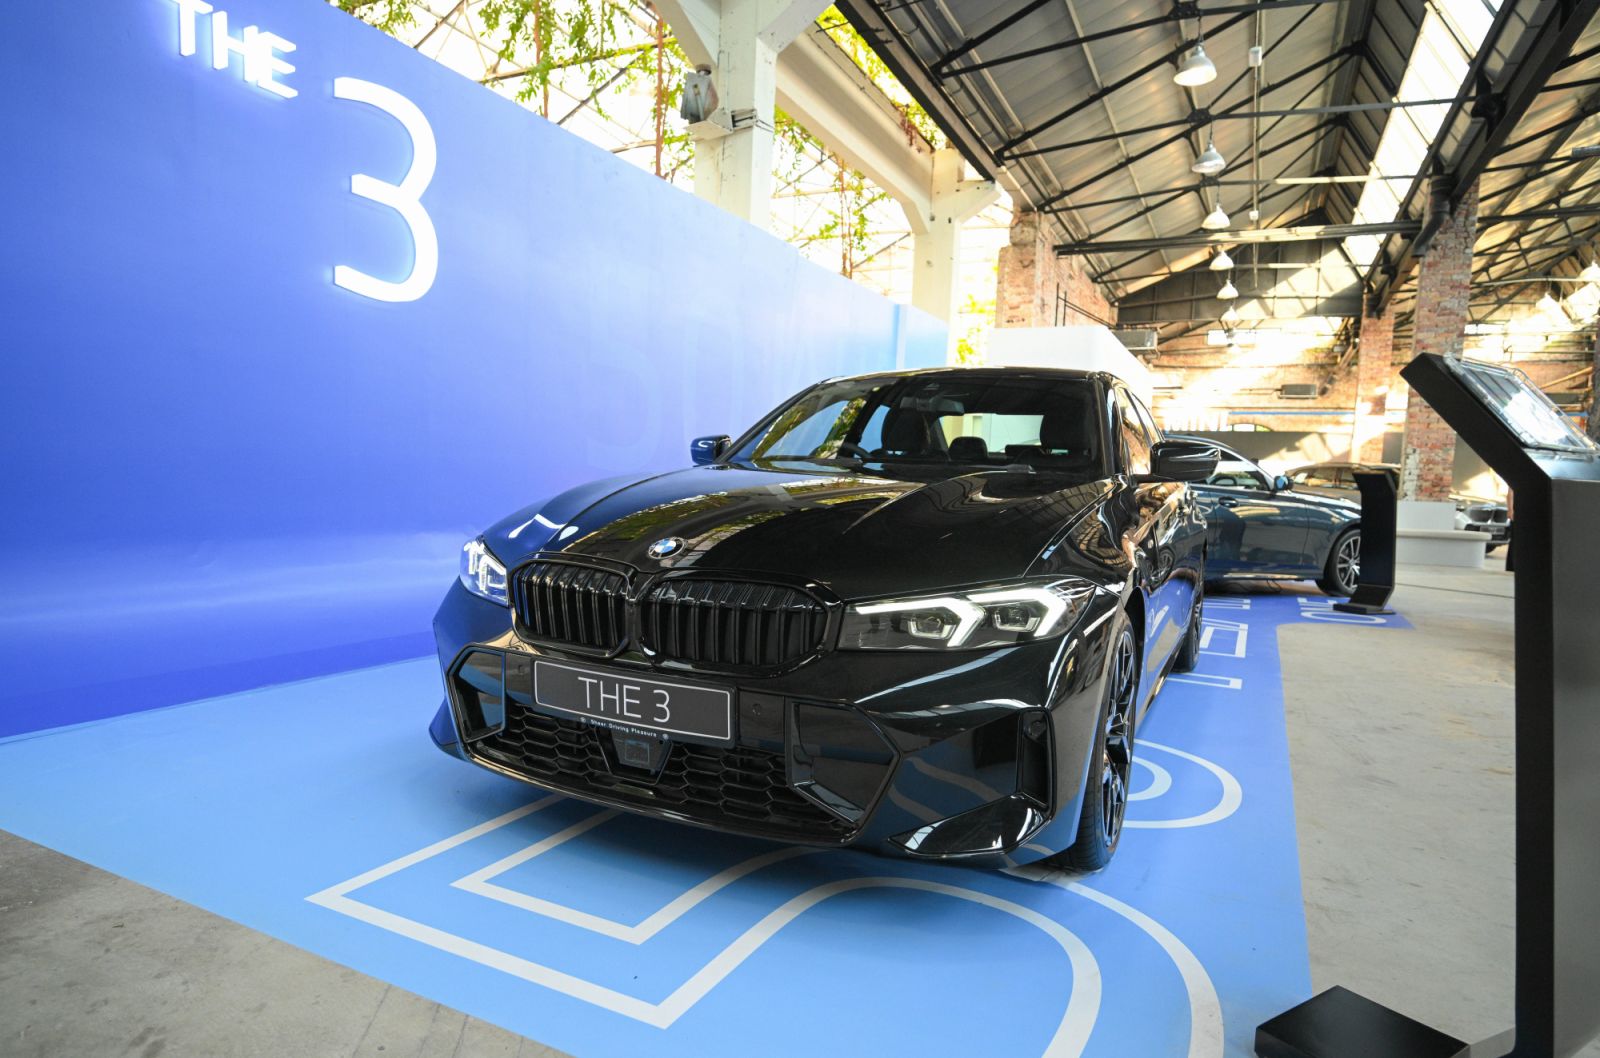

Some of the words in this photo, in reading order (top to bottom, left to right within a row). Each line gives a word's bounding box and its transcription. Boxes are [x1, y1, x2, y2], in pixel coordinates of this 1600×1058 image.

[170, 0, 299, 99] THE
[333, 76, 439, 303] 3
[577, 676, 642, 719] THE
[652, 689, 671, 723] 3
[590, 719, 607, 727] Sheer
[608, 722, 629, 733] Driving
[630, 727, 657, 738] Pleasure
